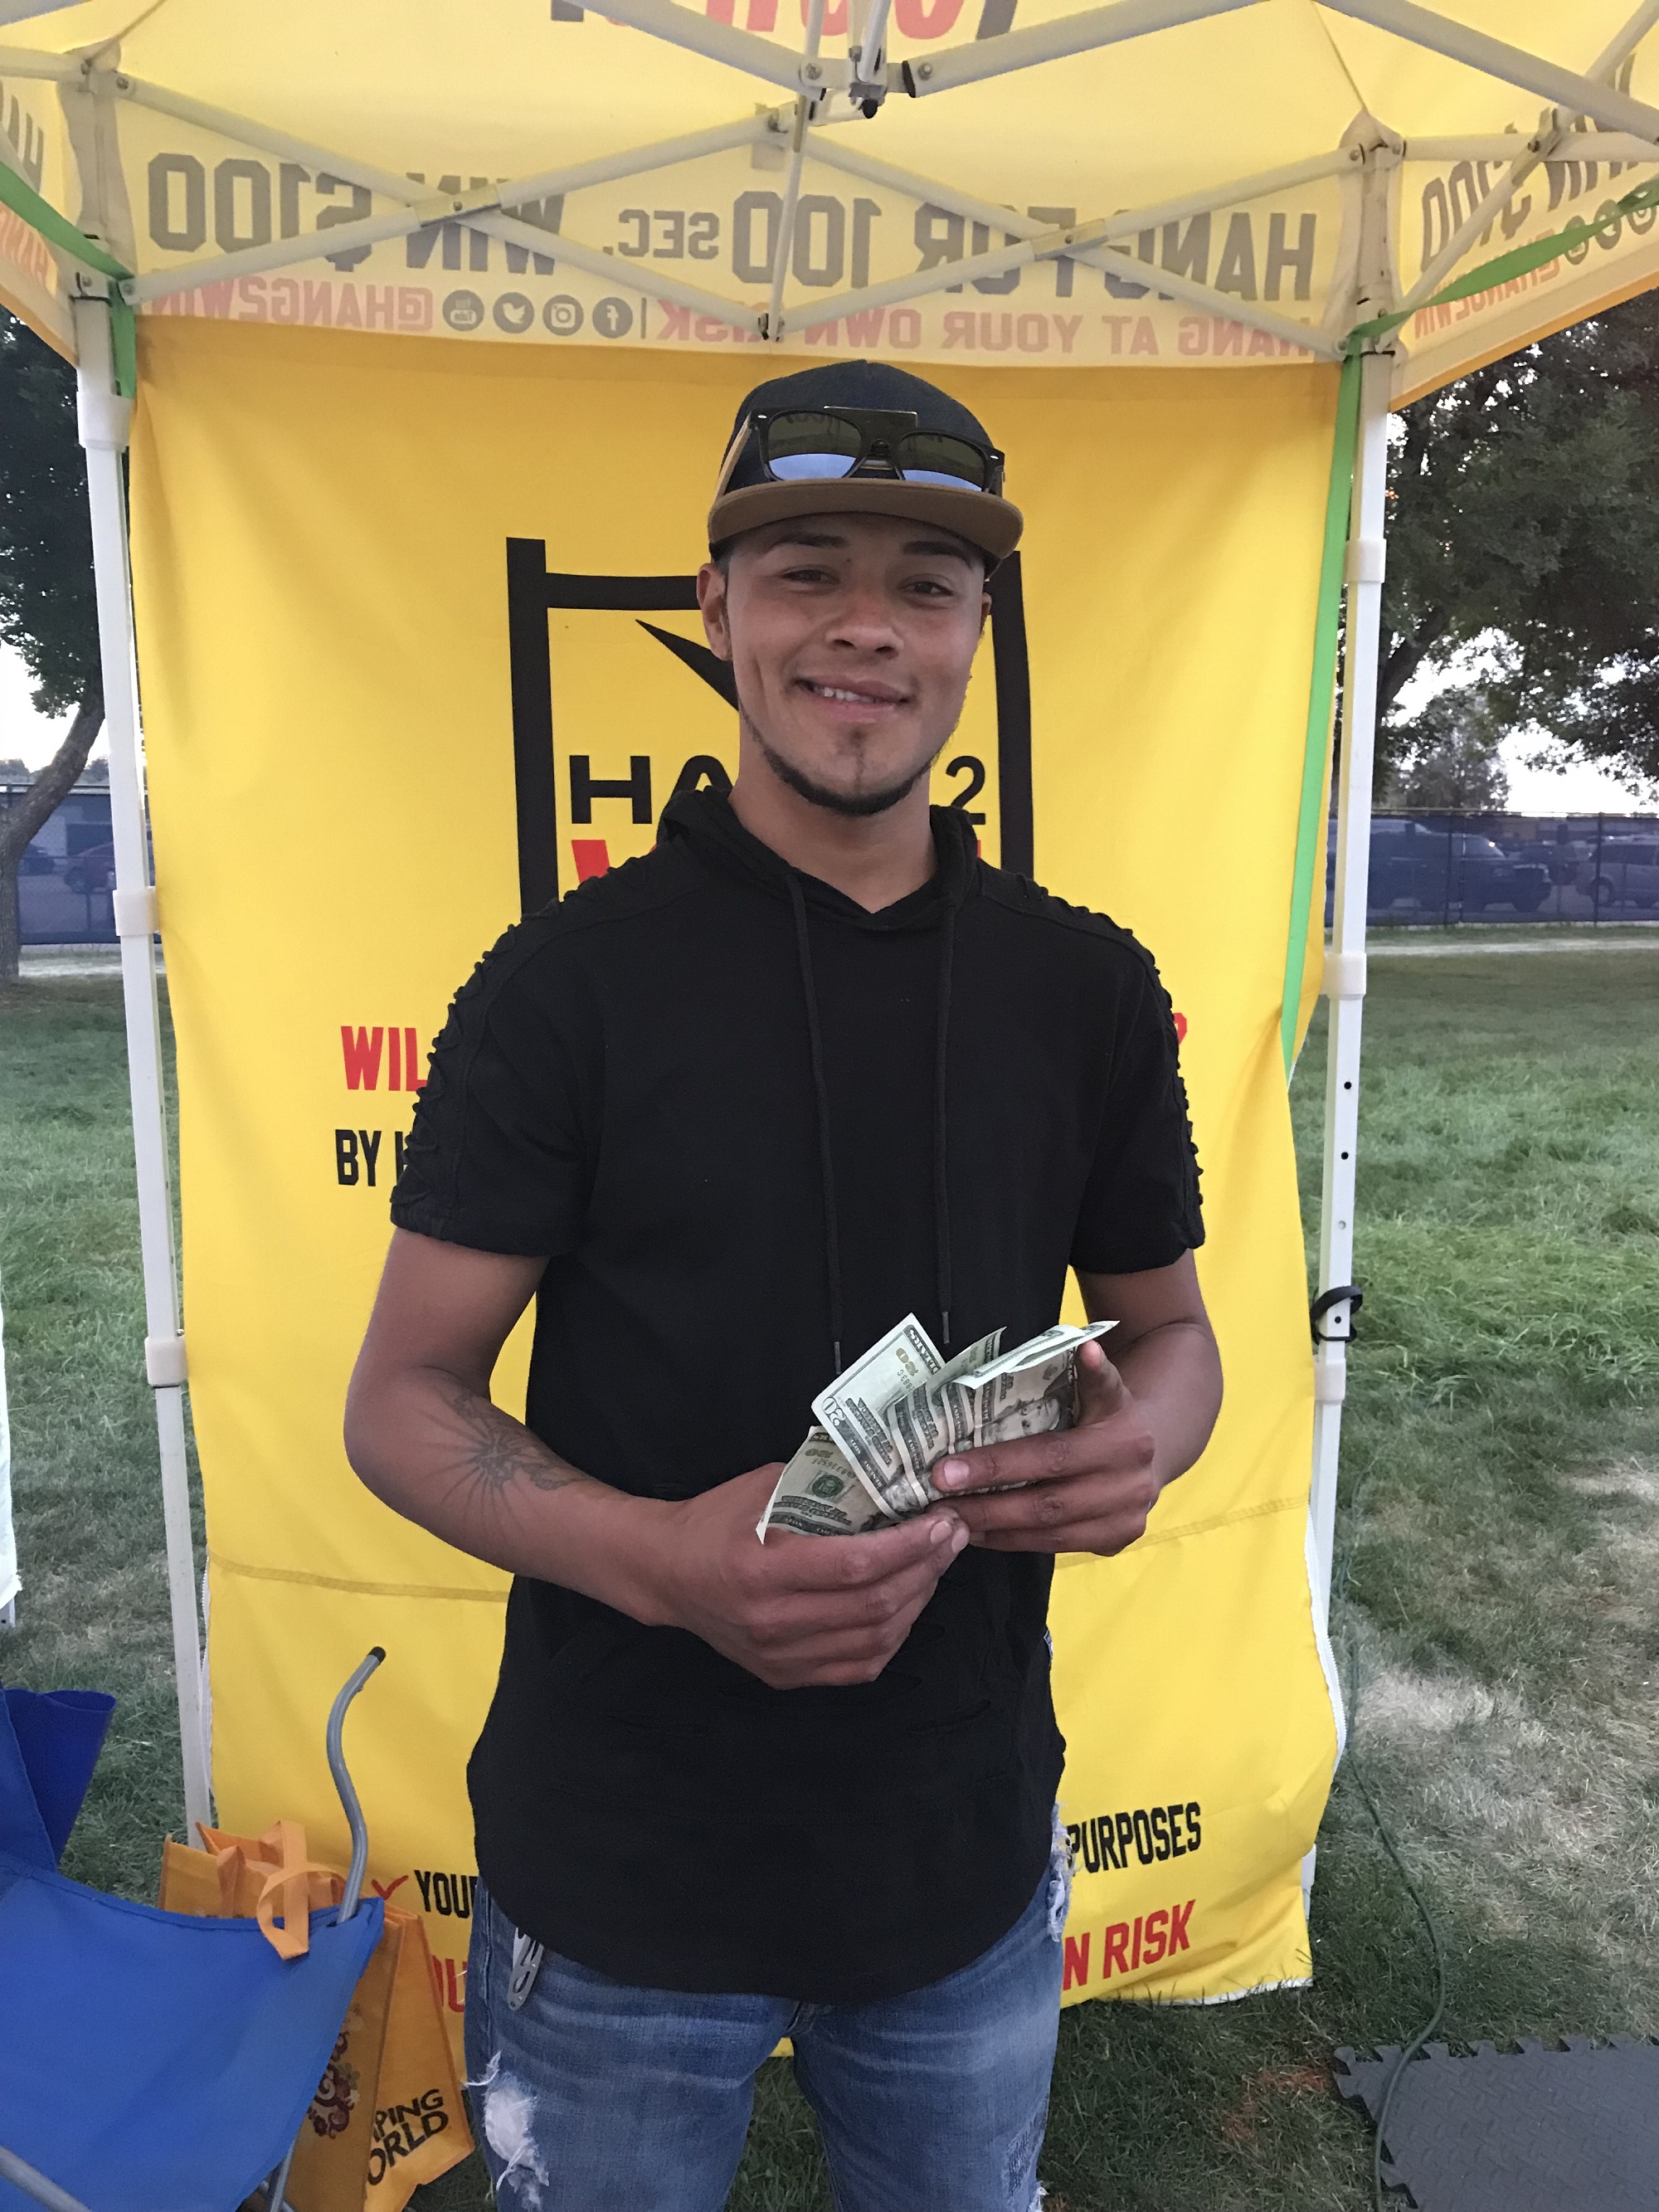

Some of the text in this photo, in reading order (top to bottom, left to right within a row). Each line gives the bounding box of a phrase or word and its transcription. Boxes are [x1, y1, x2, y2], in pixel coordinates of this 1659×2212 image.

[340, 1026, 428, 1092] WIL
[335, 1128, 382, 1186] BY
[896, 1347, 918, 1376] 20
[822, 1396, 846, 1426] 20
[1065, 1801, 1202, 1873] PURPOSES
[1102, 1898, 1196, 1980] RISK
[372, 2088, 445, 2143] PING
[367, 2110, 449, 2185] ORLD
